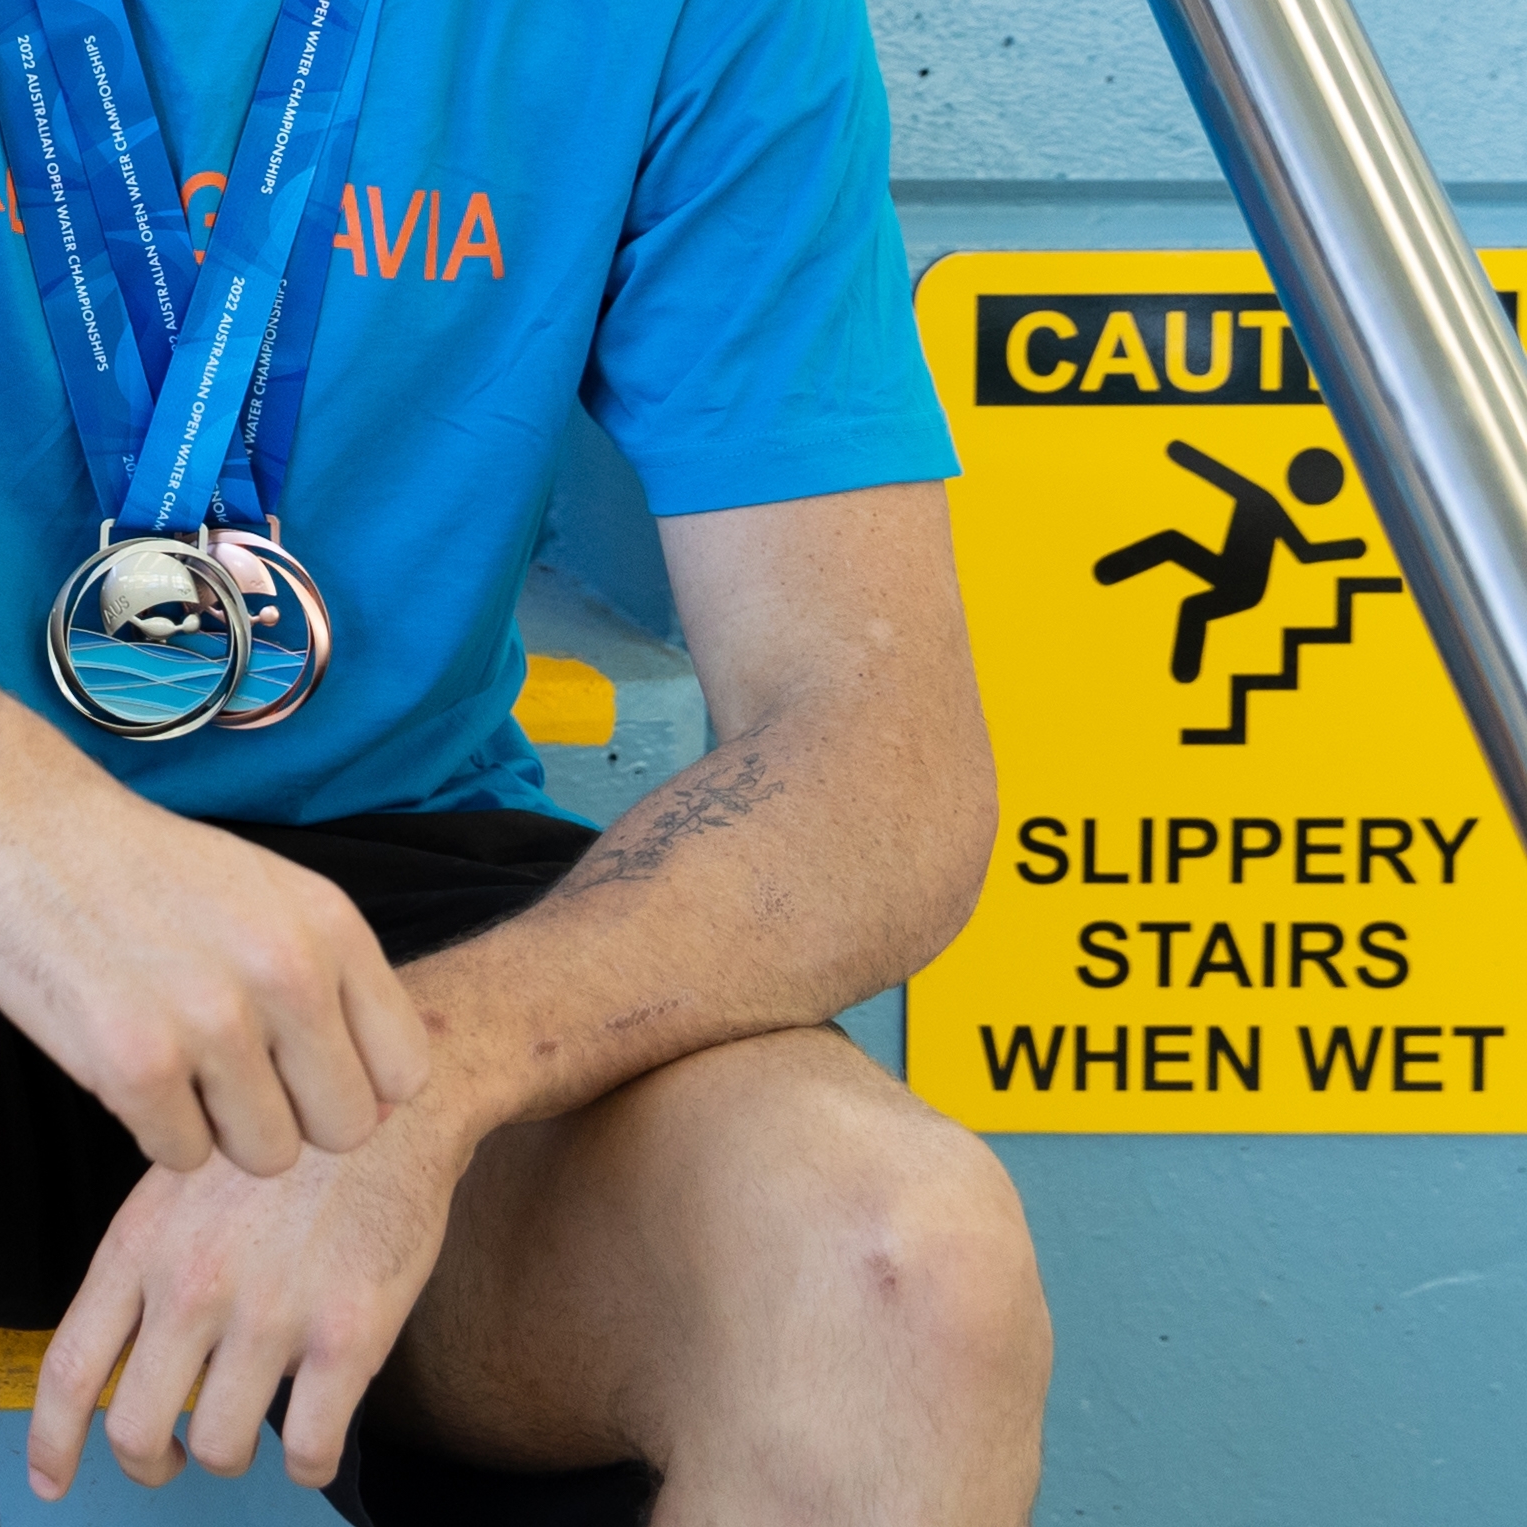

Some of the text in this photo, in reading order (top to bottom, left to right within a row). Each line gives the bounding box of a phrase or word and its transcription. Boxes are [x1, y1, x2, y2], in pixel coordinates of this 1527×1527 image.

[296, 29, 321, 77] WATER
[260, 78, 306, 196] CHAMPIONSHIPS
[16, 34, 109, 372] 2022 AUSTRALIAN OPEN WATER CHAMPIONSHIPS
[83, 34, 179, 332] AUSTRALIAN OPEN WATER CHAMPIONSHIPS
[228, 275, 246, 312] 2022
[196, 312, 234, 399] AUSTRALIAN
[1005, 309, 1320, 394] CAUT
[183, 400, 206, 442] OPEN
[244, 399, 263, 444] WATER
[167, 444, 193, 490] WATER
[103, 595, 131, 624] AUS
[1015, 816, 1480, 886] SLIPPERY
[1075, 919, 1411, 990] STAIRS
[979, 1024, 1507, 1094] WHEN WET
